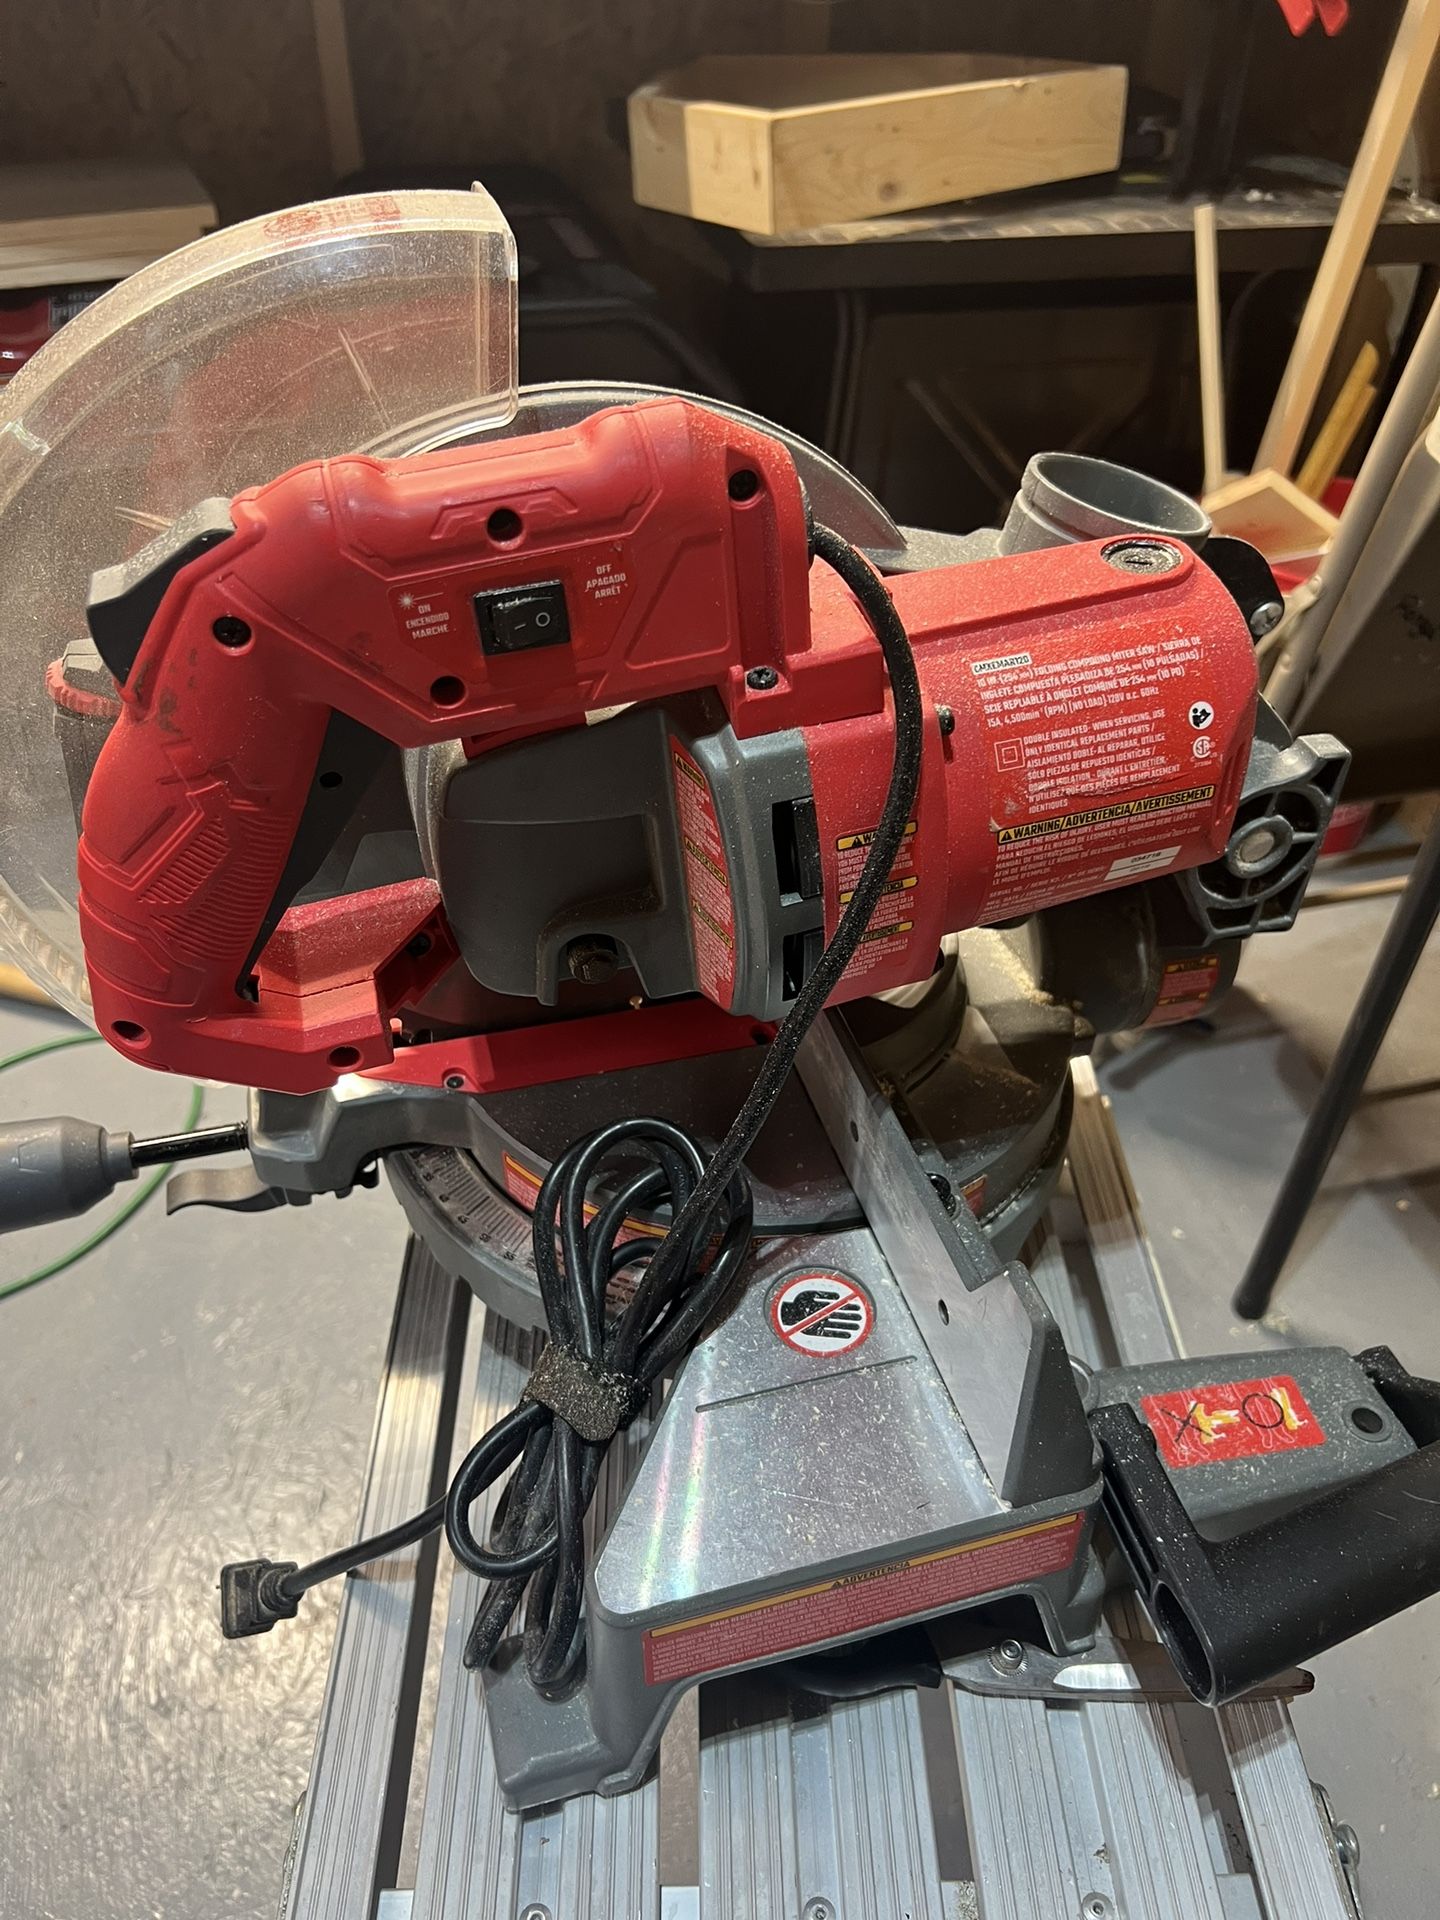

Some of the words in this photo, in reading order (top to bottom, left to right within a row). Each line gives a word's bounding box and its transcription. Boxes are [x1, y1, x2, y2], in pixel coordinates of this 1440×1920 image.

[596, 563, 612, 575] OFF
[585, 572, 627, 591] APAGADO
[593, 584, 622, 599] ARRÊT
[418, 603, 431, 614] ON
[405, 611, 450, 629] ENCENDIDO
[411, 623, 450, 640] MARCHE
[974, 655, 1029, 672] CMXEMAR120
[1034, 662, 1066, 676] FOLDING
[1067, 654, 1110, 669] COMPOUND
[1112, 648, 1135, 660] MITER
[1136, 645, 1154, 655] SAW
[1162, 638, 1190, 650] SIERRA
[1191, 635, 1201, 645] DE
[980, 687, 1011, 700] INGLETE
[1013, 677, 1060, 693] COMPUESTA
[1104, 666, 1114, 675] DE
[1116, 663, 1131, 673] 254
[1142, 658, 1154, 669] (10
[984, 703, 1000, 714] SCIE
[1003, 694, 1045, 710] REPLIABLE
[1053, 687, 1081, 700] ONGLET
[1157, 668, 1169, 680] (10
[1171, 665, 1184, 677] PO)
[1044, 702, 1067, 717] (RPM)
[1069, 700, 1081, 712] [NO
[1140, 685, 1158, 696] 60Hz
[1023, 733, 1049, 744] DOUBLE
[1092, 719, 1113, 730] WHEN
[1152, 709, 1165, 718] USE
[1025, 746, 1042, 756] ONLY
[1044, 739, 1078, 752] IDENTICAL
[1080, 729, 1126, 745] REPLACEMENT
[1127, 724, 1149, 735] PARTS
[1026, 752, 1071, 767] AISLAMIENTO
[1097, 745, 1105, 753] AL
[1141, 734, 1165, 744] UTILICE
[1046, 765, 1069, 775] PIEZAS
[1081, 756, 1114, 768] REPUESTO
[1097, 766, 1123, 777] DURANT
[1120, 776, 1128, 784] DE
[1129, 765, 1179, 781] REMPLACEMENT
[1029, 799, 1067, 813] IDENTIQUES
[843, 1561, 910, 1584] ADVERTENCIA
